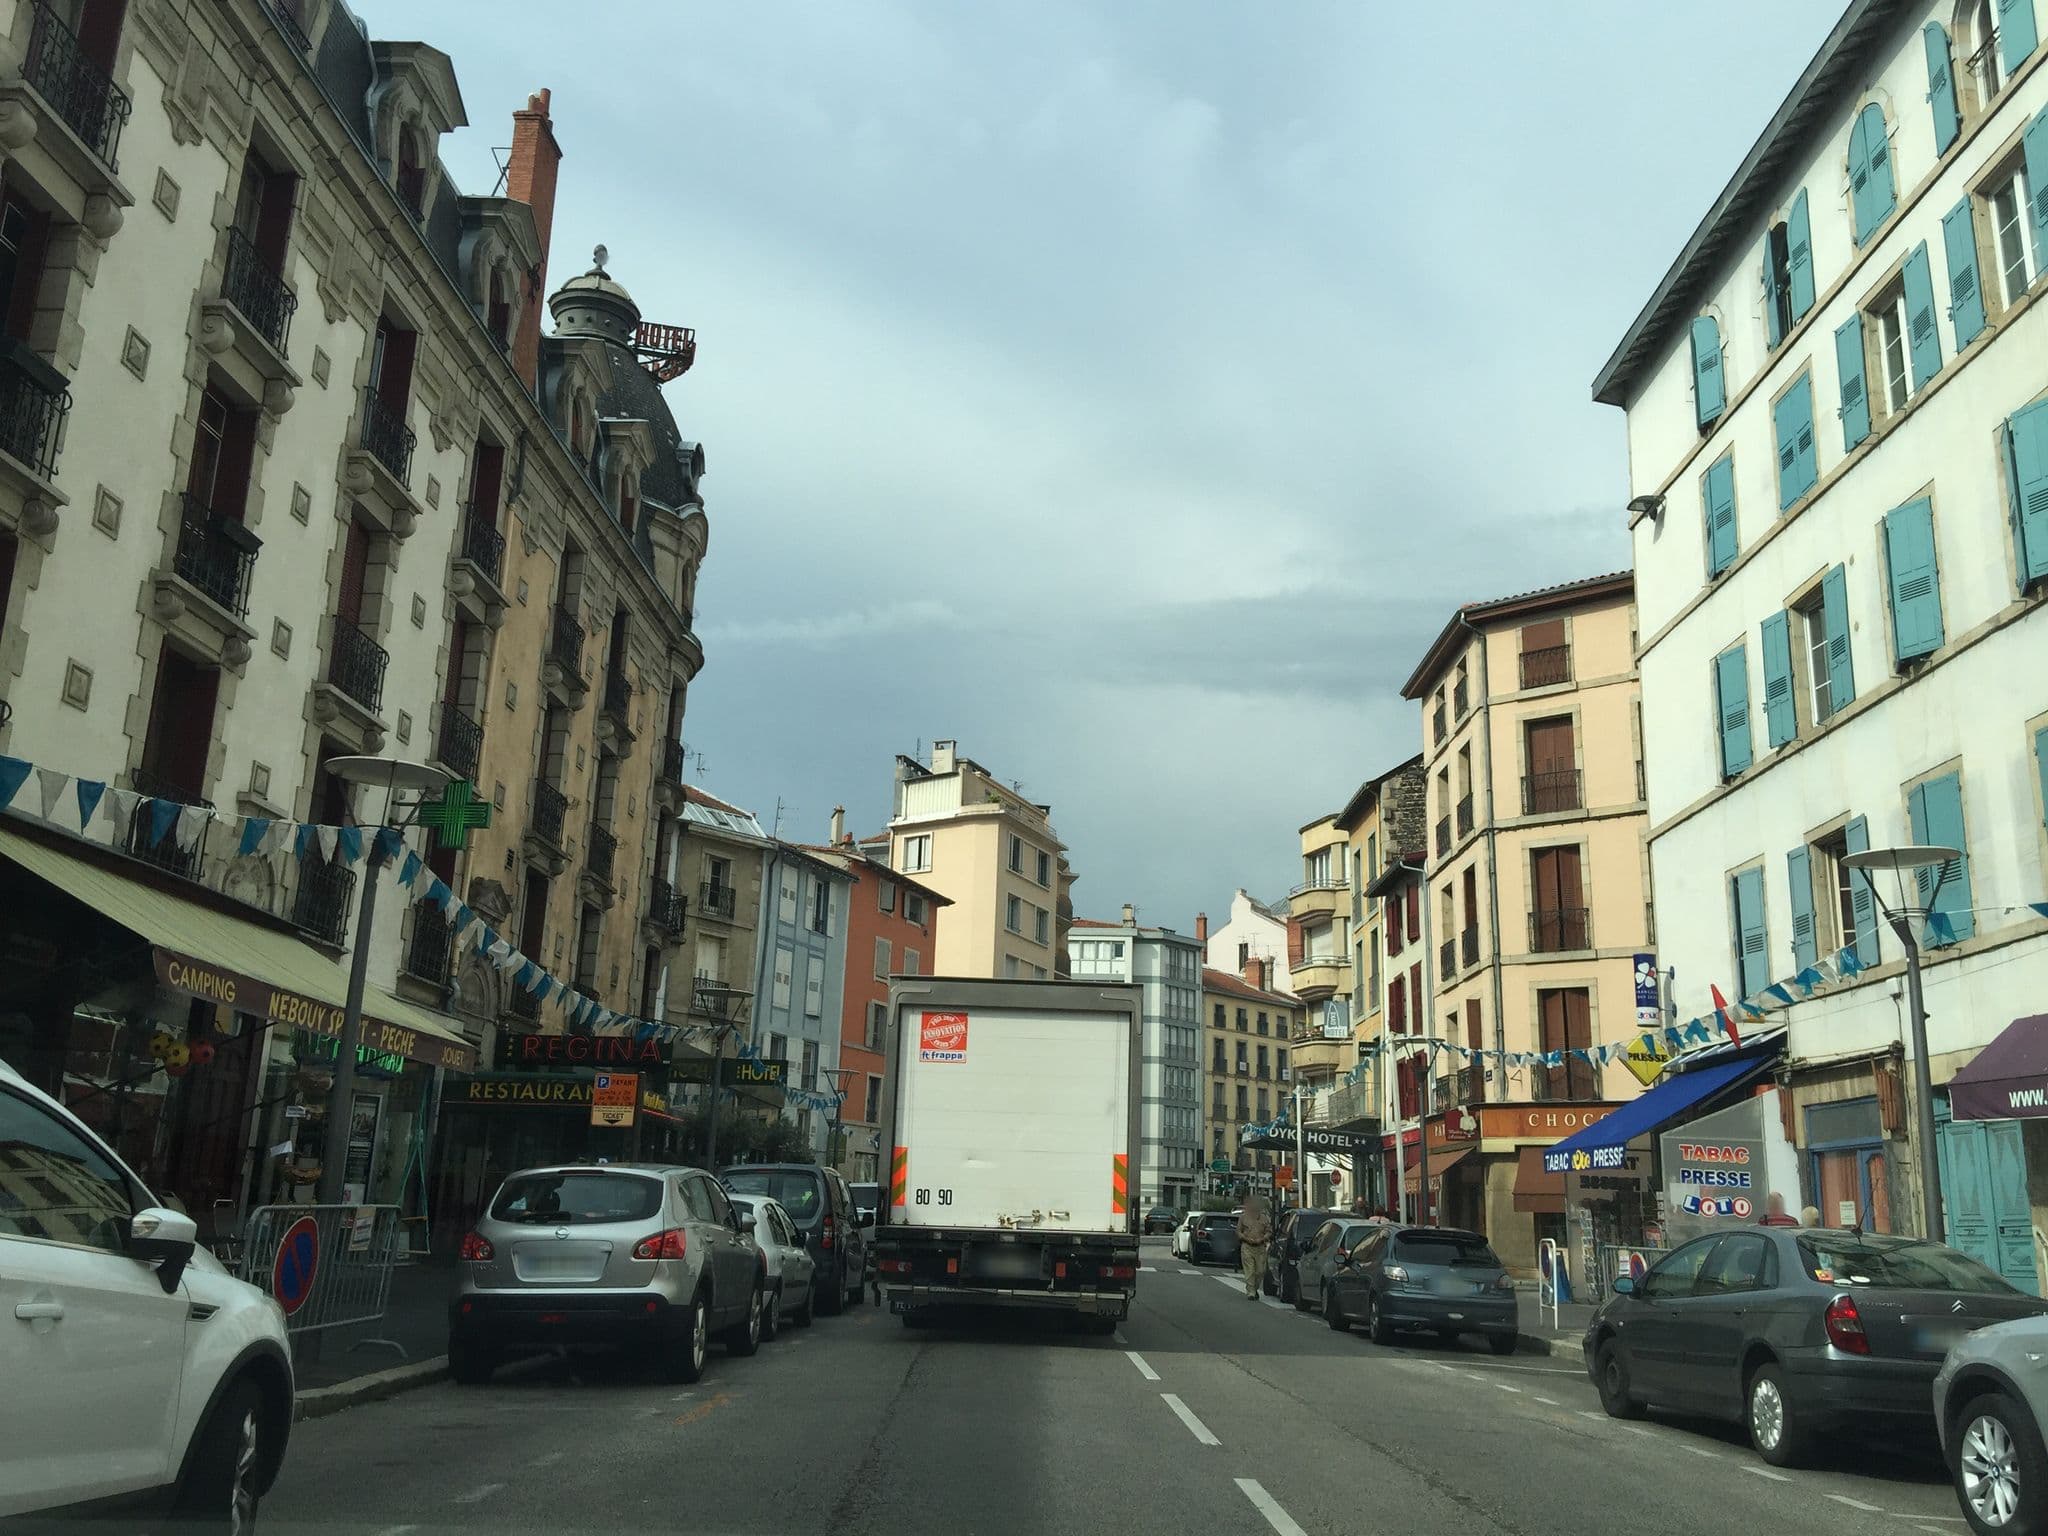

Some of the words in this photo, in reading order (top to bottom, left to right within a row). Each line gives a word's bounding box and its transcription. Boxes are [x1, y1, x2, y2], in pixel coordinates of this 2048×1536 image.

[635, 322, 690, 353] HOTEL
[168, 961, 236, 1003] CAMPING
[268, 991, 328, 1032] NEBOUY
[379, 1025, 416, 1056] PECHE
[923, 1022, 966, 1040] INNOVATION
[522, 1035, 661, 1062] REGINA
[931, 1051, 963, 1060] frappa
[1628, 1052, 1667, 1062] PRESSE
[469, 1081, 594, 1101] RESTAURAN
[1269, 1127, 1304, 1140] DYK
[1307, 1132, 1353, 1147] HOTEL
[1545, 1152, 1569, 1171] TABAC
[1679, 1144, 1750, 1163] TABAC
[1680, 1168, 1751, 1187] PRESSE
[916, 1188, 930, 1205] 80
[938, 1189, 952, 1206] 90
[1682, 1194, 1752, 1218] LOTO
